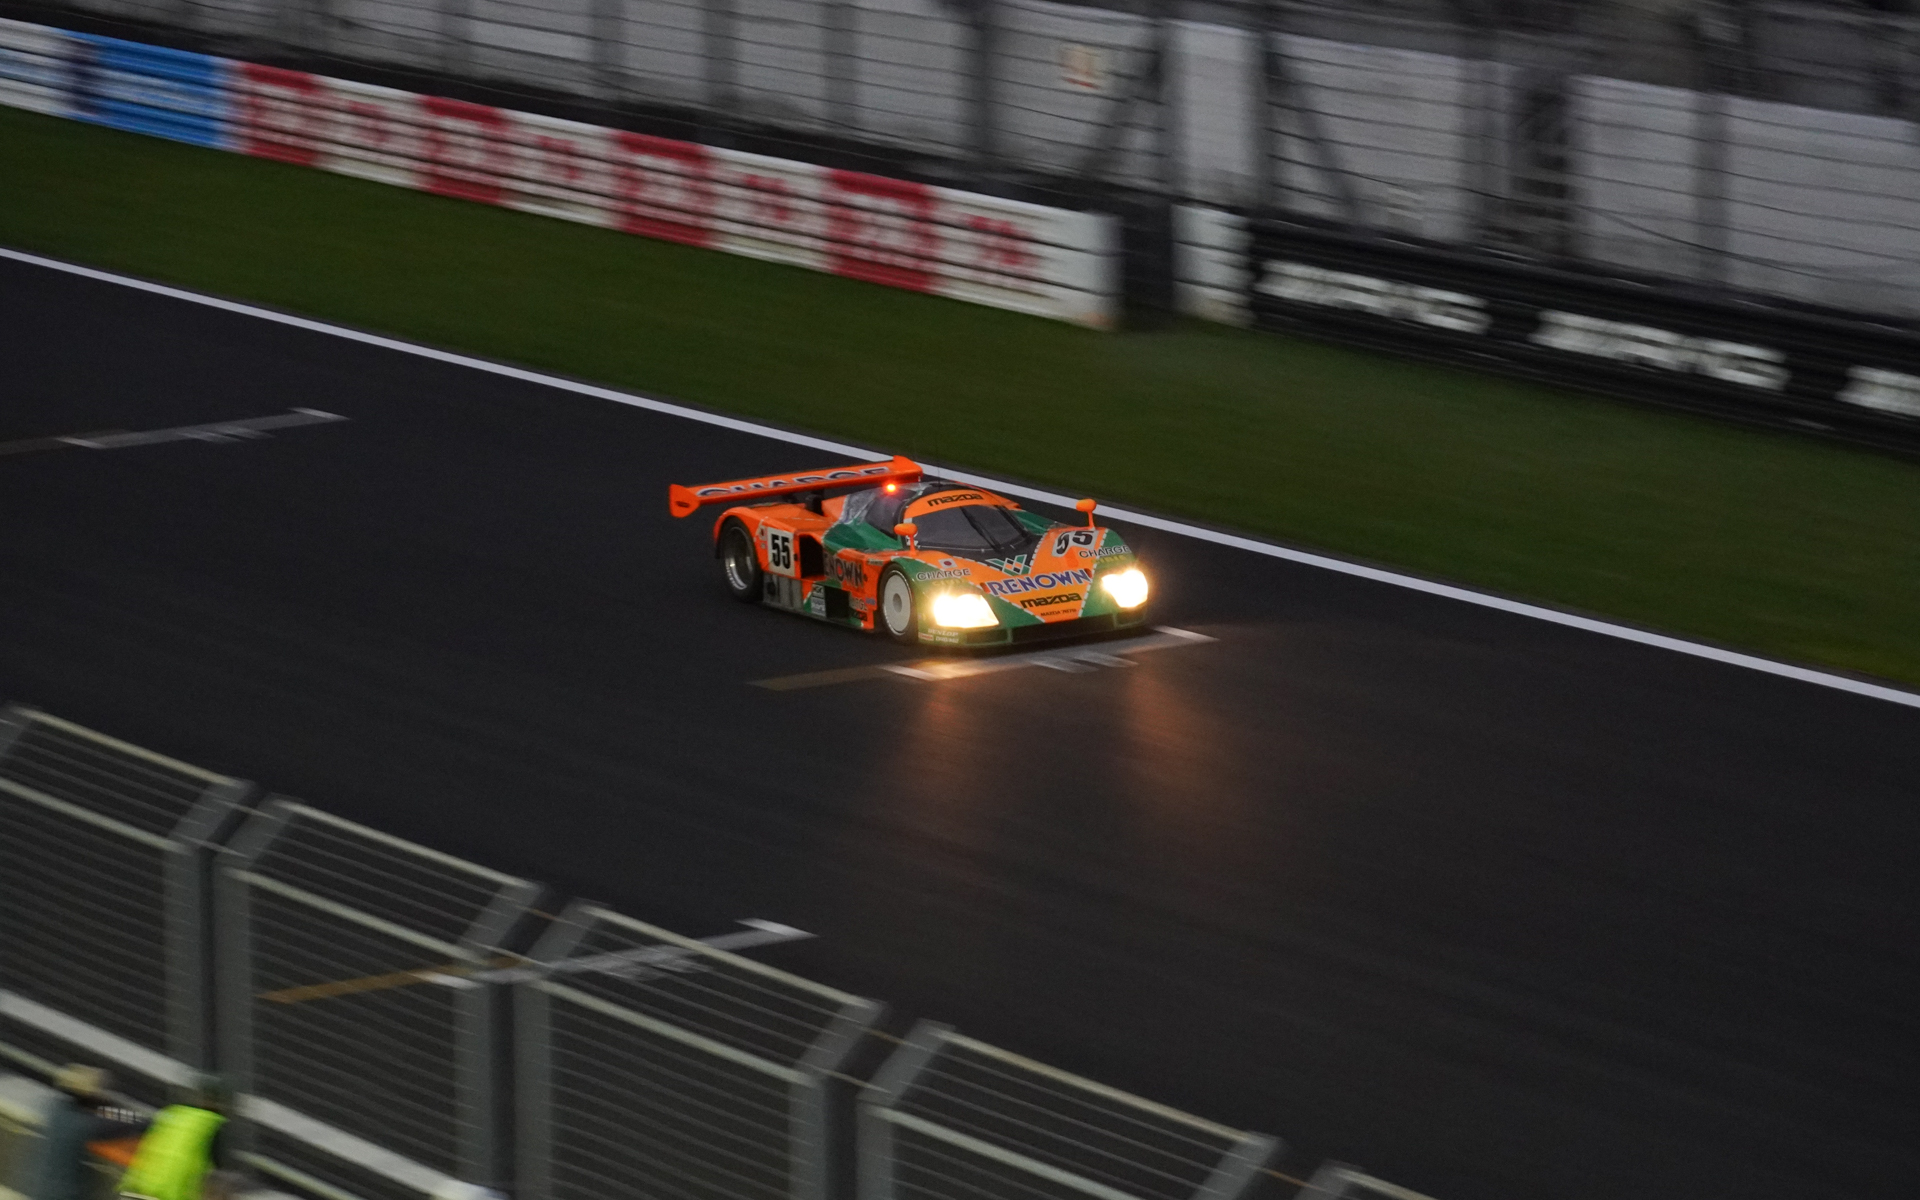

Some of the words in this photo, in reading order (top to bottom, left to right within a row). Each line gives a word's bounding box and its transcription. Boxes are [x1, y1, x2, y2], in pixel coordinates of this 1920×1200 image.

[771, 533, 791, 570] 55
[916, 568, 971, 581] CHARGE
[986, 568, 1093, 597] RENOWN
